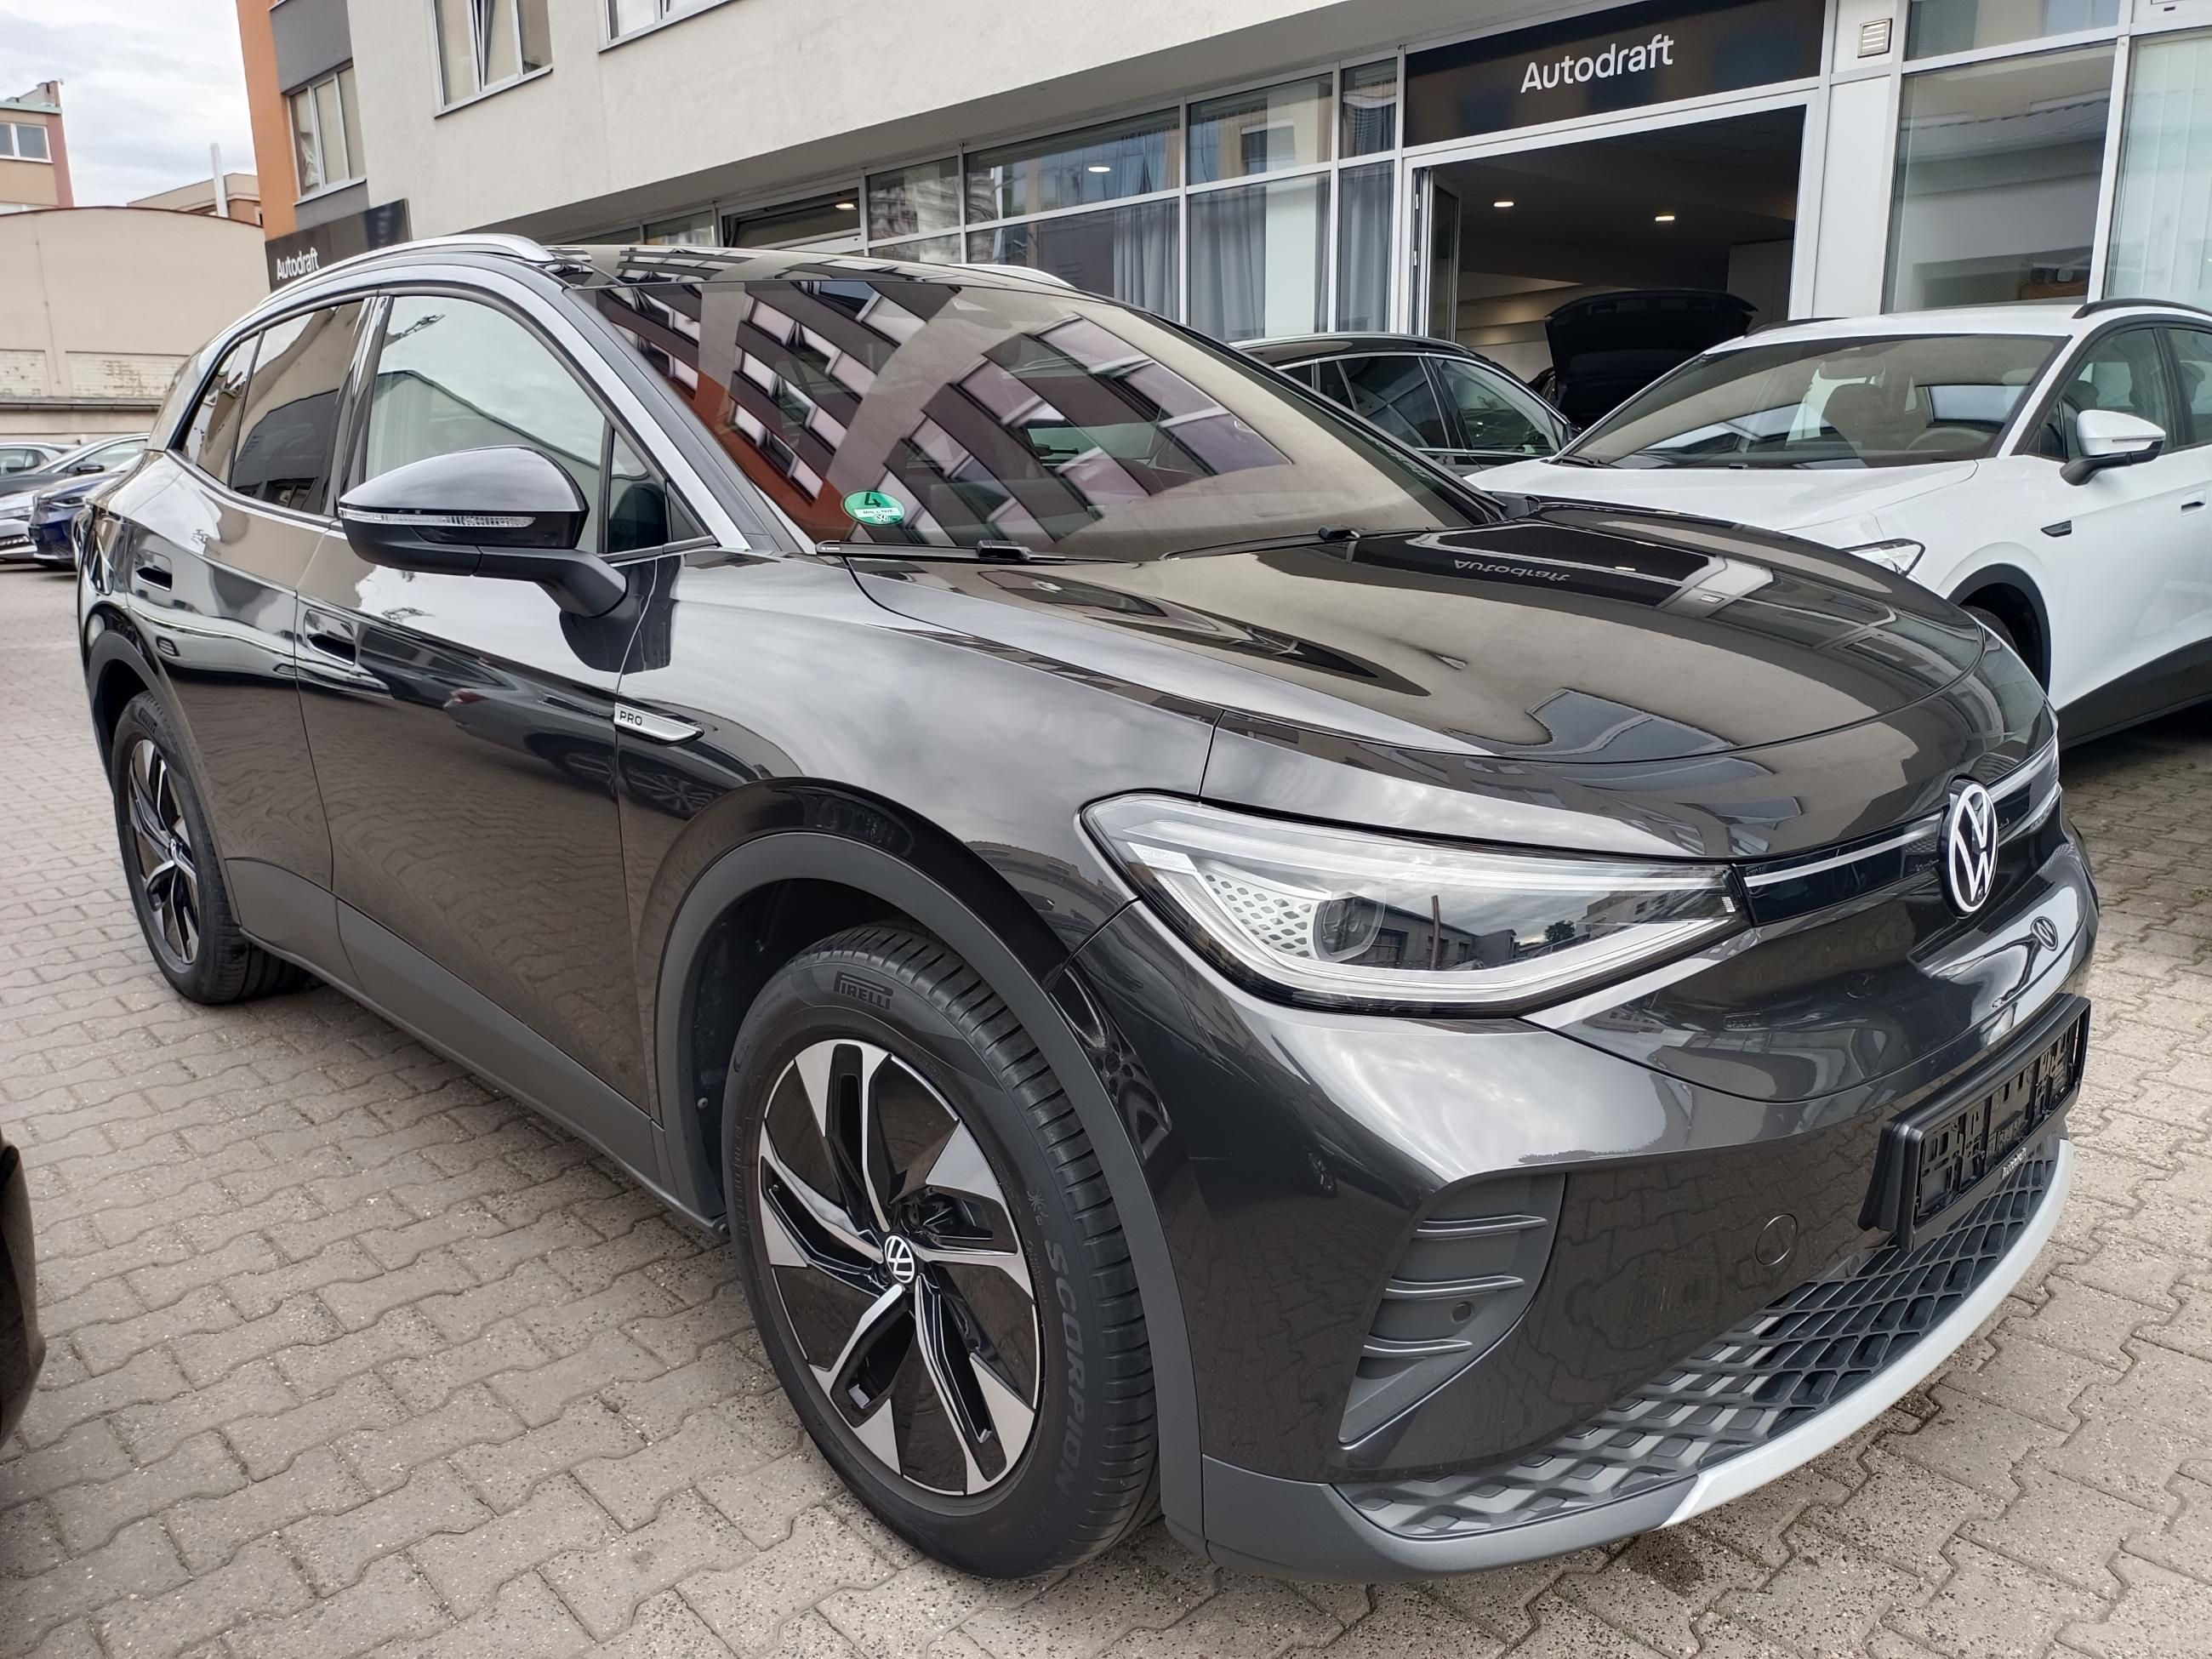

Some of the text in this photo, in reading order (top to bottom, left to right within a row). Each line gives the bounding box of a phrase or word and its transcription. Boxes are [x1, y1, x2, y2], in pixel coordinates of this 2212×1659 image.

[1519, 33, 1674, 94] Autodraft
[276, 247, 320, 281] Autodraft
[619, 710, 643, 726] PRO
[834, 971, 894, 1011] PIRELLI
[1044, 1239, 1086, 1497] SCORPION
